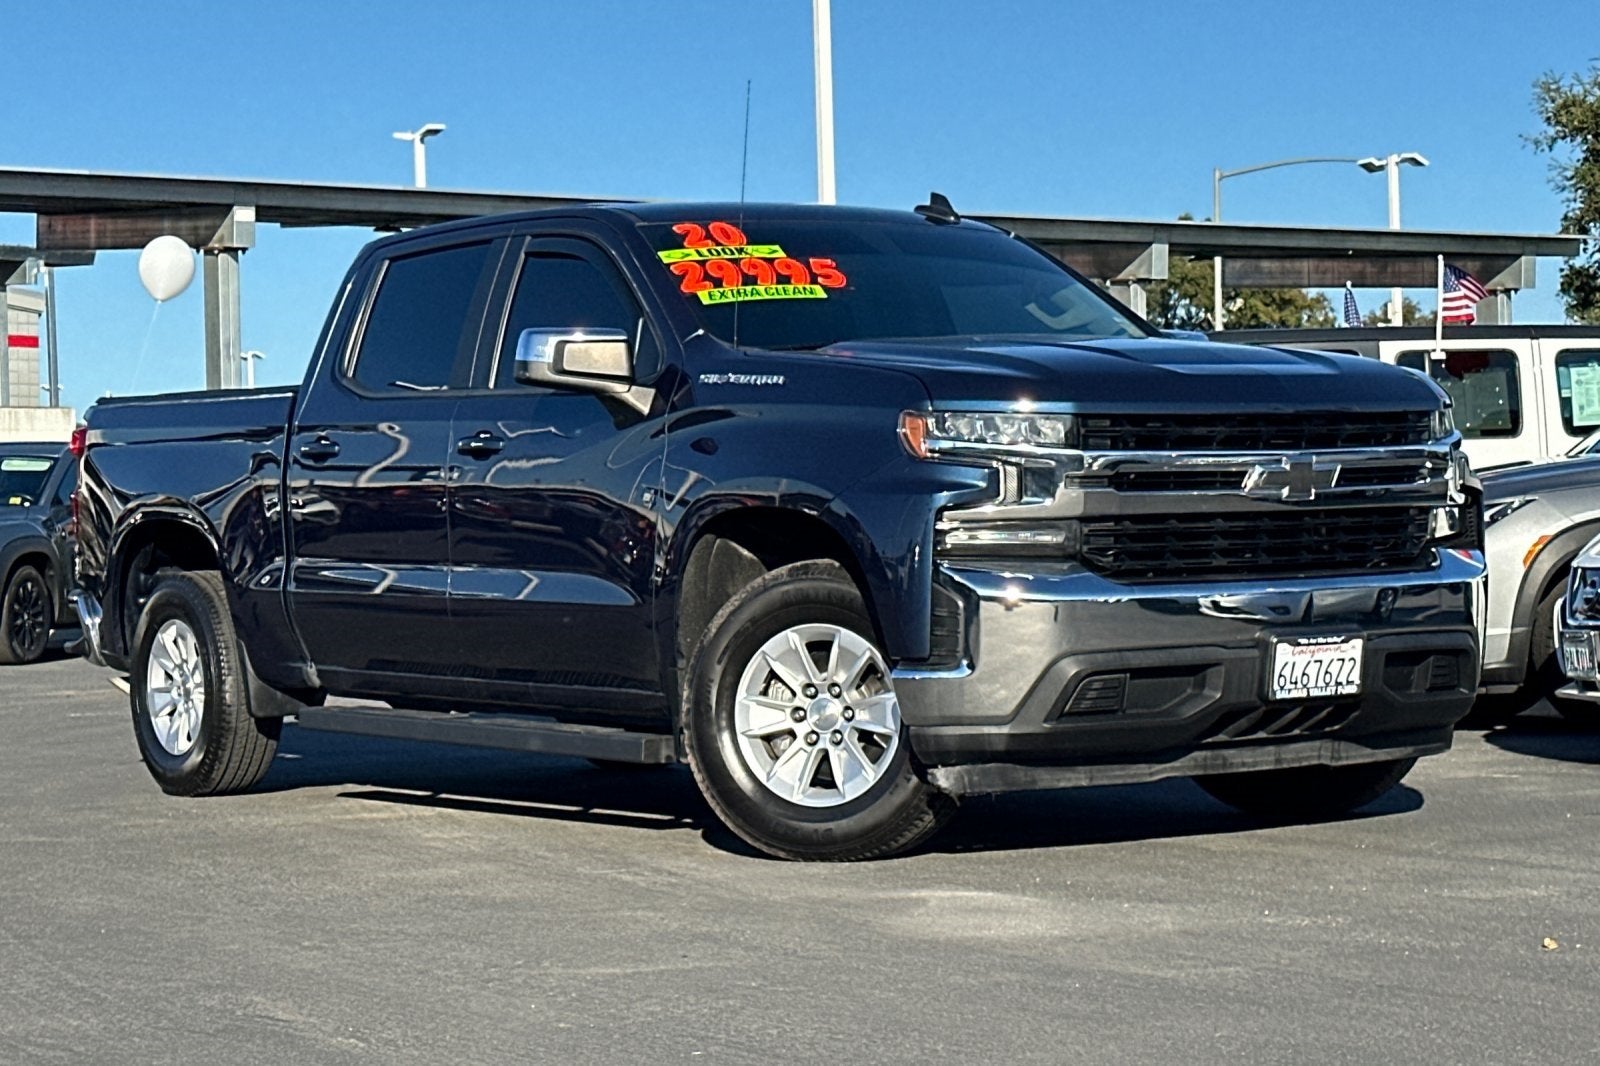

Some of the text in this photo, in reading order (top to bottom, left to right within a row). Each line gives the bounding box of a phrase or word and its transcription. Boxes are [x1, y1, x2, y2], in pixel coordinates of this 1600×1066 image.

[672, 221, 747, 248] 20
[694, 247, 752, 258] LOOK
[670, 257, 847, 293] 29995
[707, 285, 816, 301] EXTRA CLEAN
